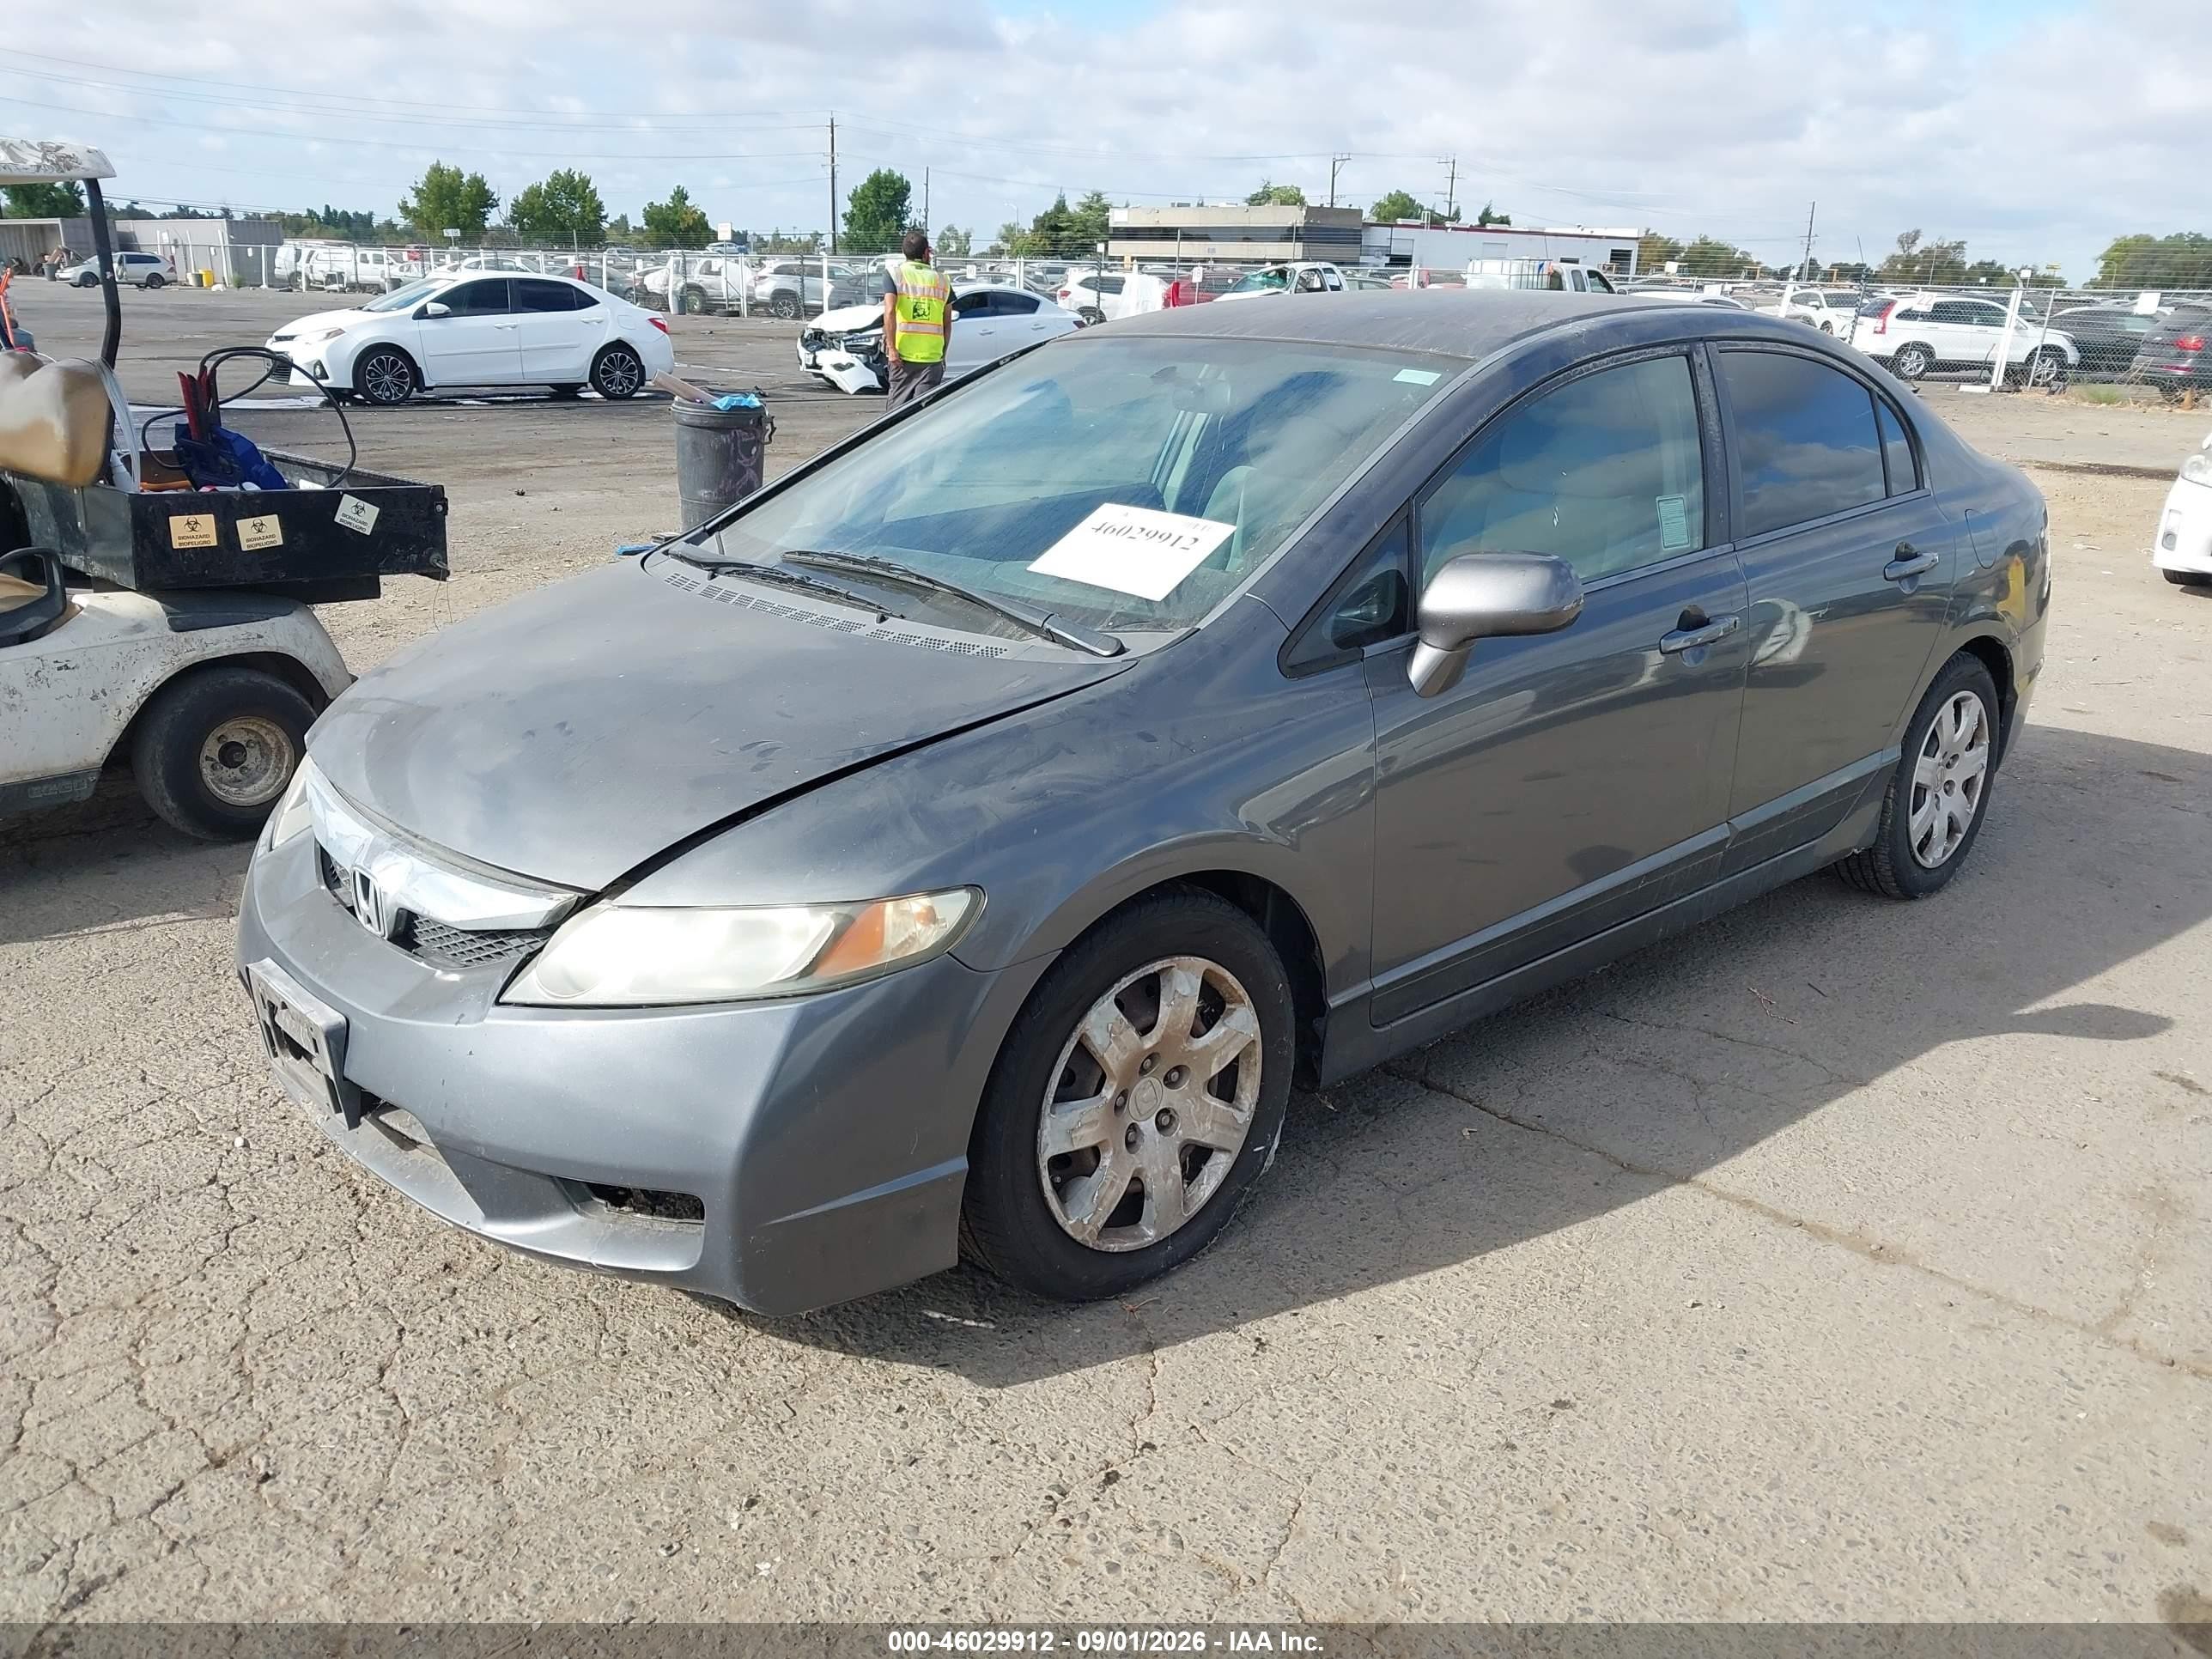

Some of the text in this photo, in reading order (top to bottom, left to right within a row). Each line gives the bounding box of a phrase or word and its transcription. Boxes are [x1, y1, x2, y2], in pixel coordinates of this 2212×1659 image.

[1917, 294, 1934, 306] 22
[339, 518, 367, 532] BIOPELIGRO
[341, 512, 368, 526] BIOHAZARD
[246, 534, 276, 543] BIOHAZARD
[1091, 521, 1200, 550] 46029912
[246, 540, 277, 549] BIOPELIGRO
